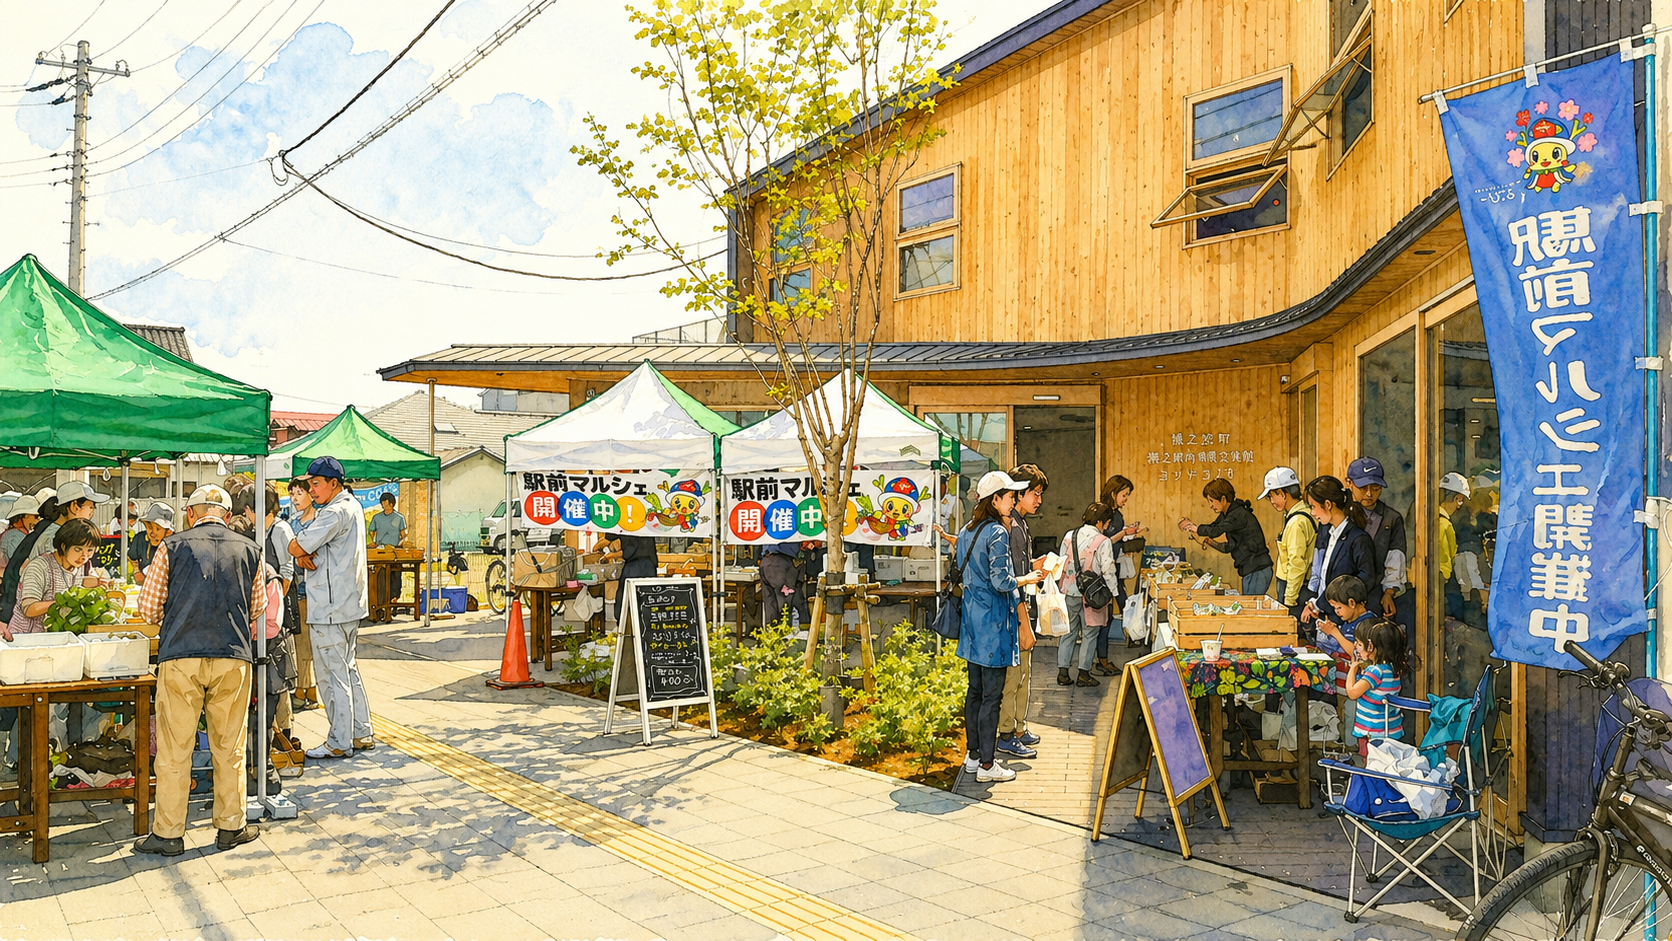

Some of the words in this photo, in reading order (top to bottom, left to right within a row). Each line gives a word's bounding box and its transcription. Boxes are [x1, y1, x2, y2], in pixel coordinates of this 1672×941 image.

[523, 472, 648, 496] 駅前マルシェ
